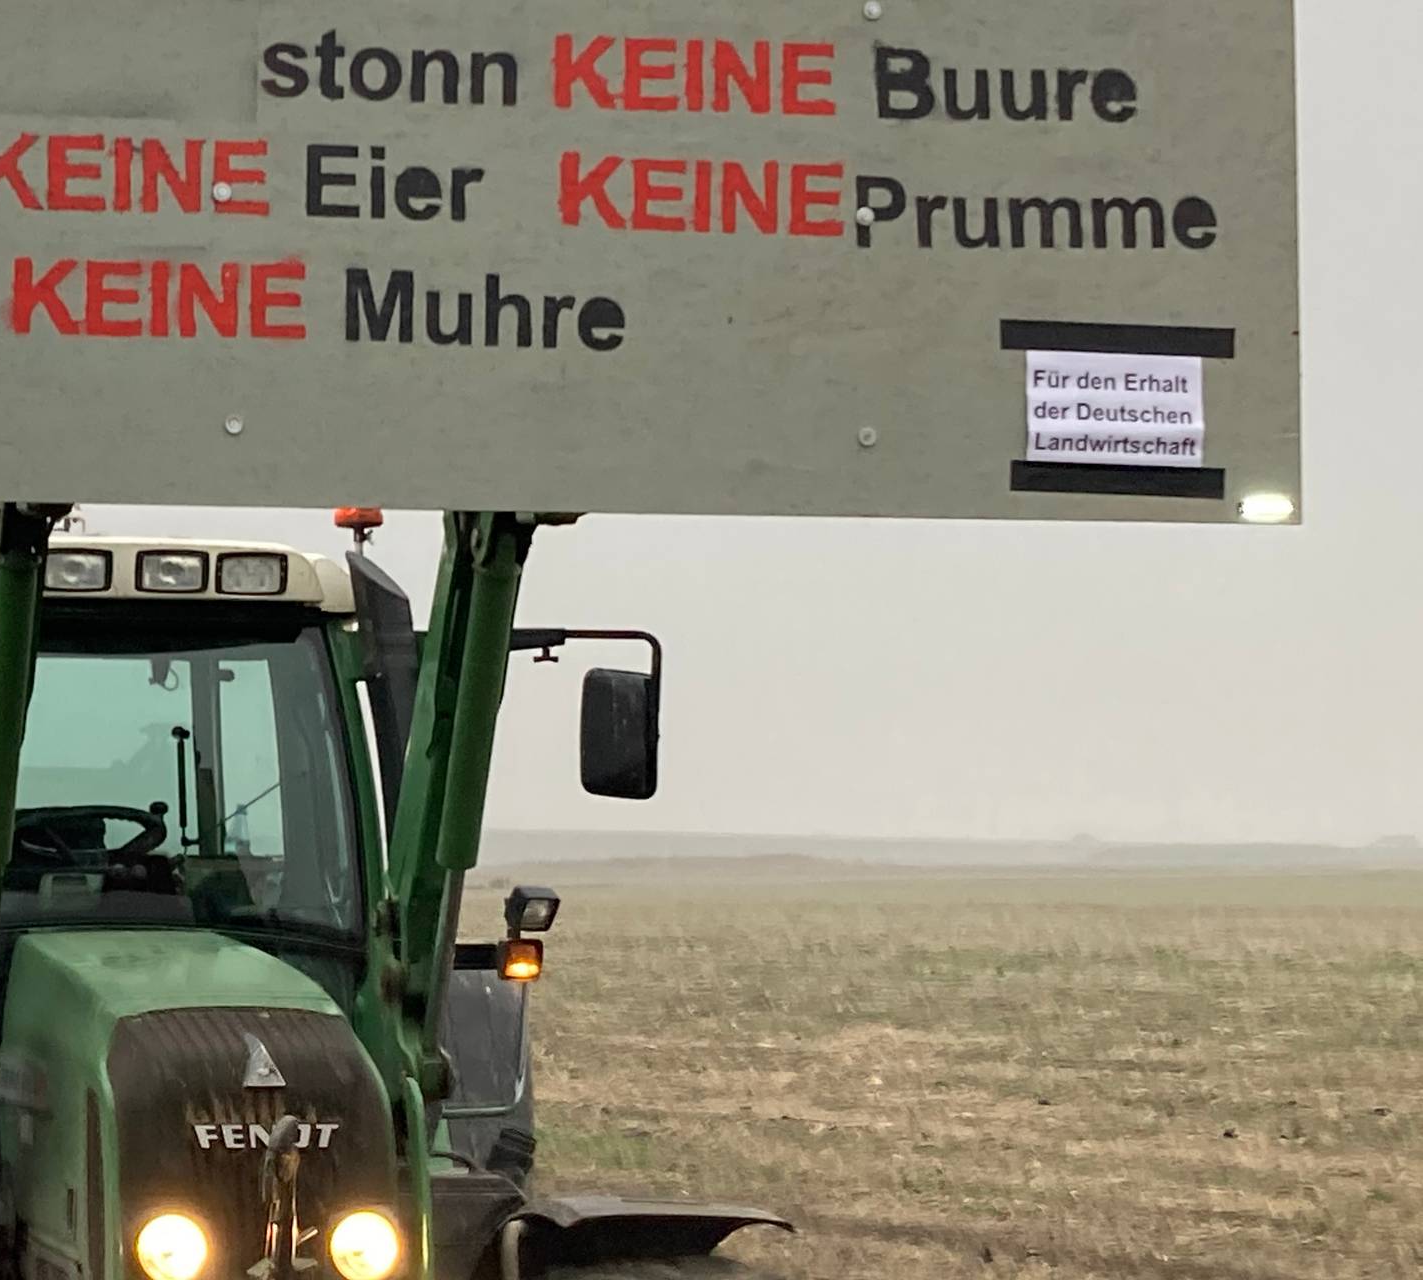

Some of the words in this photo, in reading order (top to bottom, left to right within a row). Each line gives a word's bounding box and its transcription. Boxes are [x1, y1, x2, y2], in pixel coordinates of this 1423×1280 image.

[261, 29, 518, 106] stonn
[552, 34, 836, 116] KEINE
[875, 40, 1138, 122] Buure
[306, 144, 484, 221] Eier
[557, 151, 844, 237] KEINE
[855, 175, 1217, 249] Prumme
[7, 257, 306, 340] KEINE
[345, 268, 626, 351] Muhre
[1032, 369, 1070, 389] Für
[1076, 372, 1117, 391] den
[1124, 373, 1189, 394] Erhalt
[1033, 401, 1070, 420] der
[1076, 402, 1193, 425] Deutschen
[1034, 432, 1197, 457] Landwirtschaft
